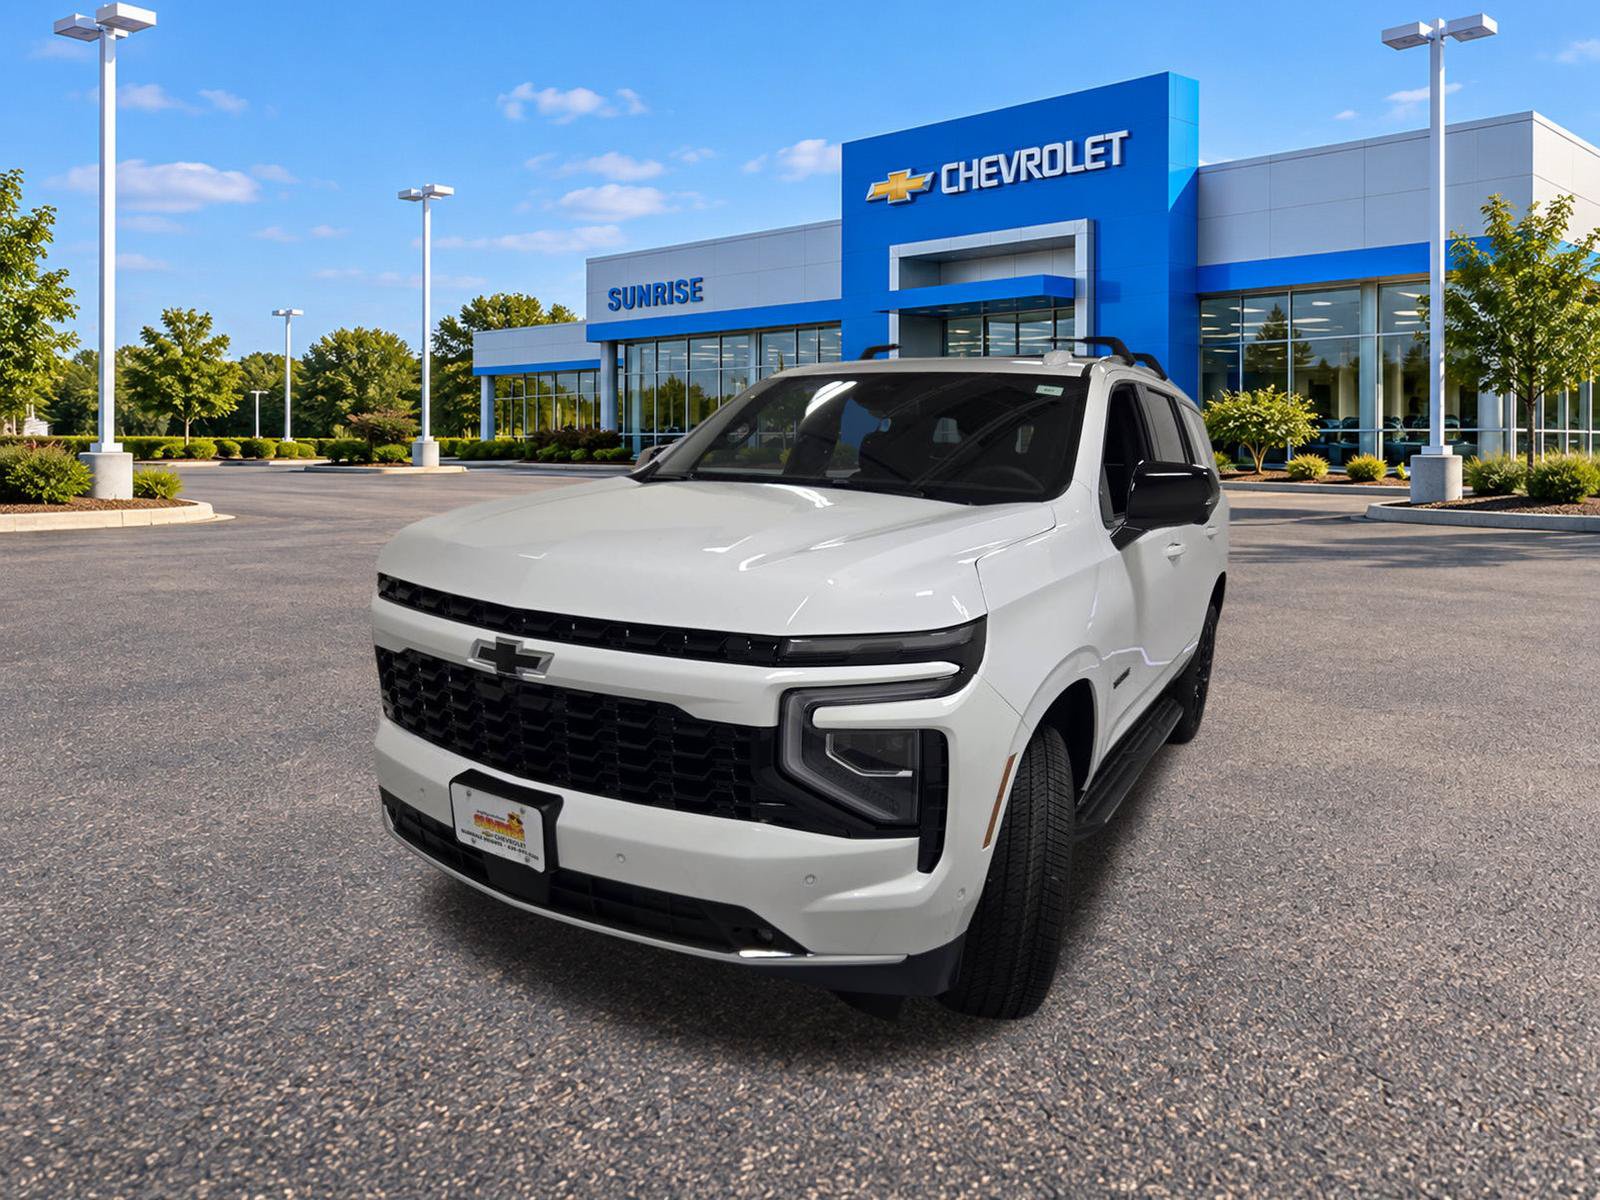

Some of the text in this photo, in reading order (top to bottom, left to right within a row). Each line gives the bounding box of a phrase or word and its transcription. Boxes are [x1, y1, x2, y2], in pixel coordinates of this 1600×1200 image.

[941, 130, 1129, 194] CHEVROLET
[607, 277, 704, 311] SUNRISE
[494, 834, 526, 849] CHEVROLET
